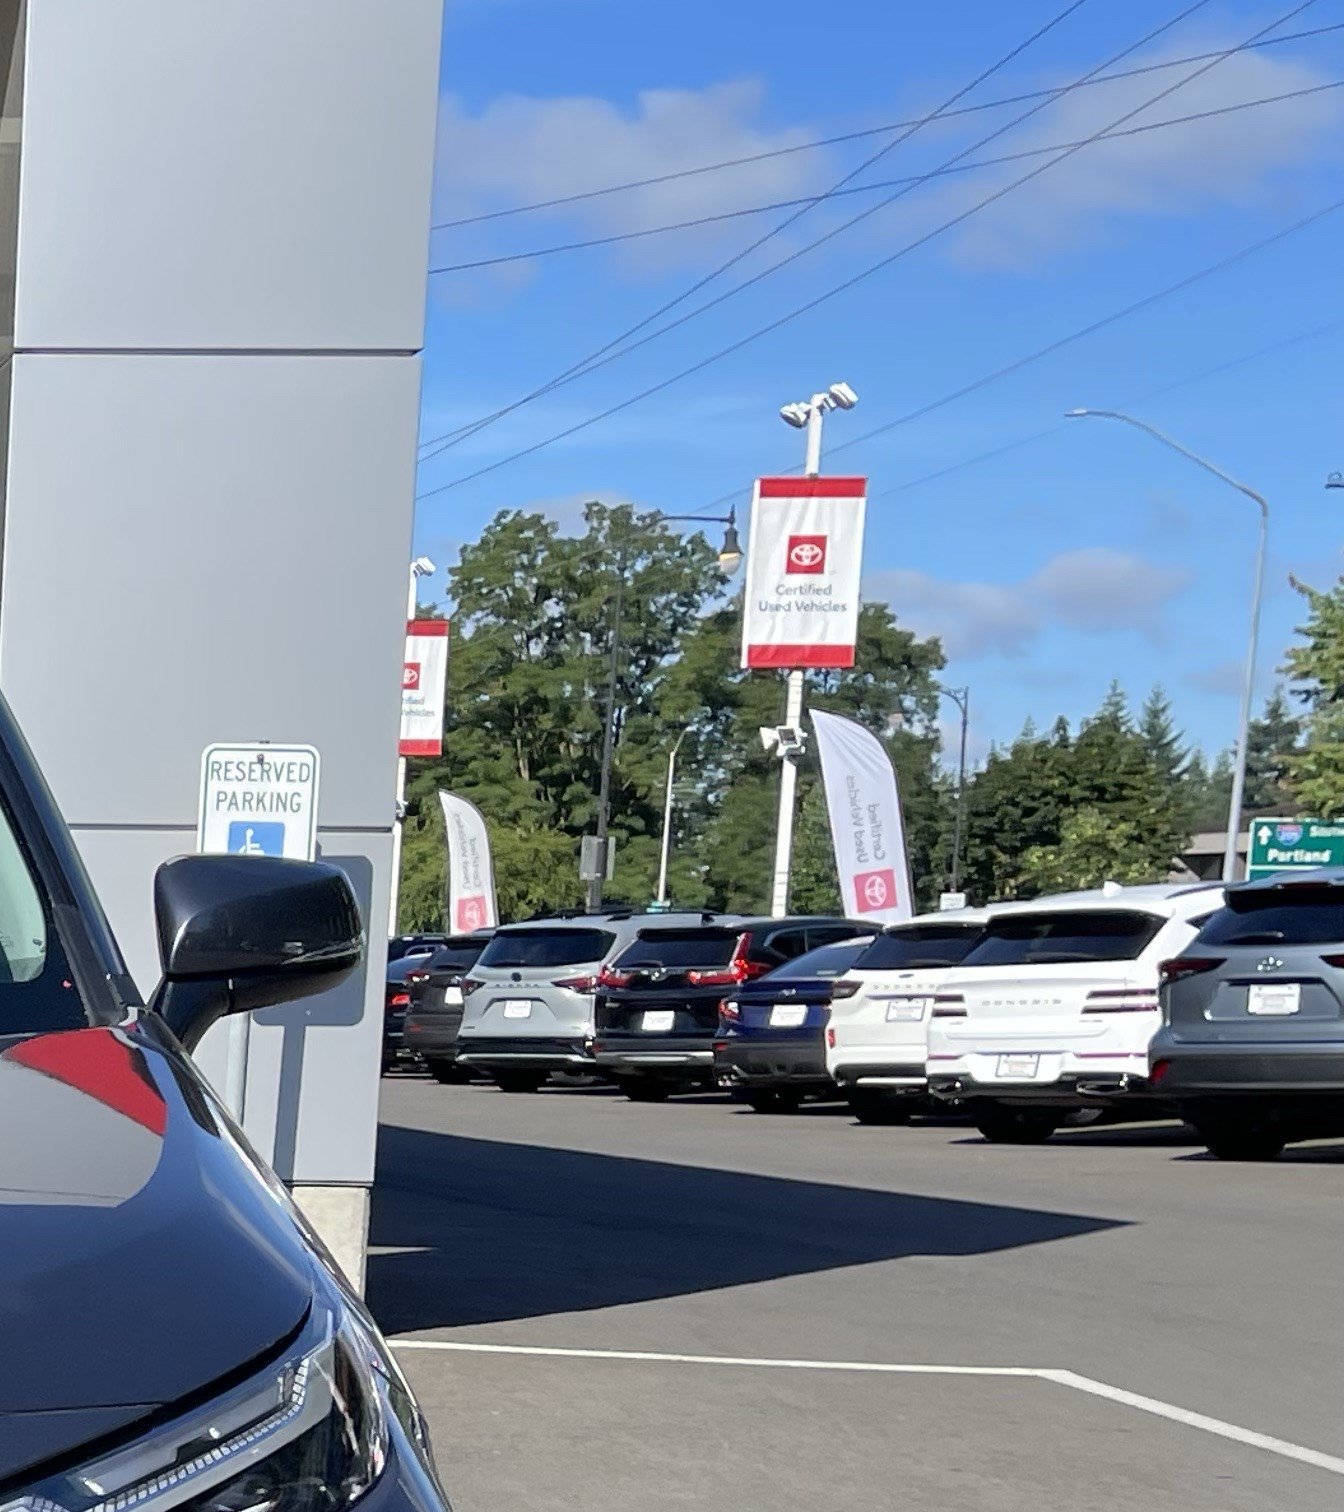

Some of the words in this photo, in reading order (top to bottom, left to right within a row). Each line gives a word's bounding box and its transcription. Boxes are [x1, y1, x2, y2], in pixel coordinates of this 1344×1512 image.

[776, 584, 833, 596] Certified
[758, 600, 792, 612] Used
[794, 600, 848, 613] Vehicles
[210, 760, 311, 783] RESERVED
[215, 790, 303, 813] PARKING
[1267, 848, 1332, 863] Portland
